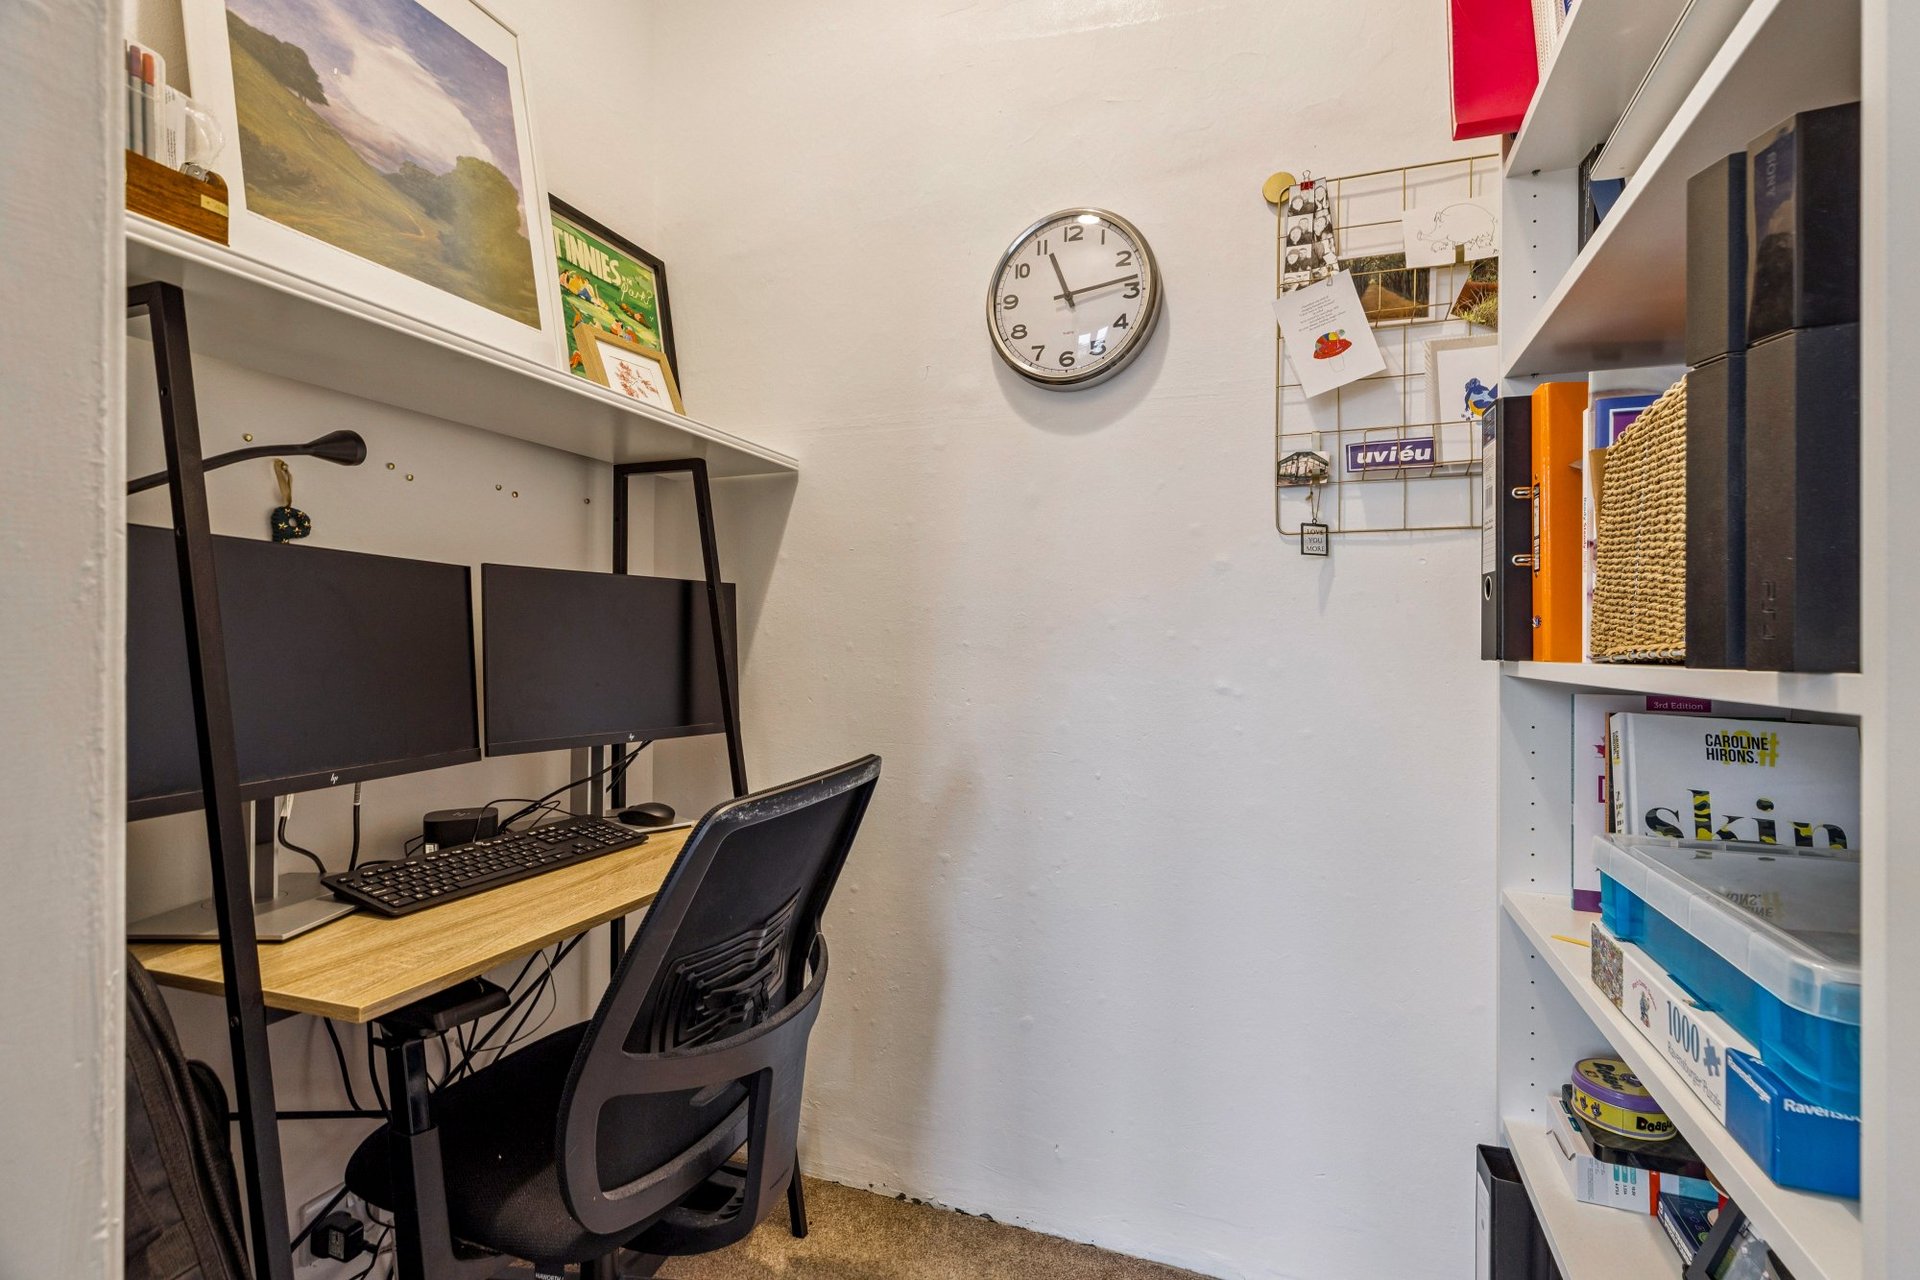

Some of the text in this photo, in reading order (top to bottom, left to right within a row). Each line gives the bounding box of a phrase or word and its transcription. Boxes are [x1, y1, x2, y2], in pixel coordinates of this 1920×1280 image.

[1063, 225, 1084, 243] 12
[1101, 229, 1106, 245] 1
[552, 225, 621, 286] TINNIES
[1036, 239, 1048, 256] 11
[1115, 250, 1132, 267] 2
[1015, 263, 1031, 280] 10
[1122, 281, 1140, 299] 3
[1003, 294, 1019, 310] 9
[1112, 313, 1129, 330] 4
[1010, 324, 1028, 340] 8
[1031, 345, 1045, 362] 7
[1089, 339, 1106, 356] 5
[1058, 351, 1075, 368] 6
[1356, 445, 1432, 464] uviéu
[1653, 701, 1704, 710] 3rd Edition
[1705, 733, 1769, 751] CAROLINE
[1706, 747, 1758, 764] HIRONS.
[1667, 1000, 1700, 1063] 1000
